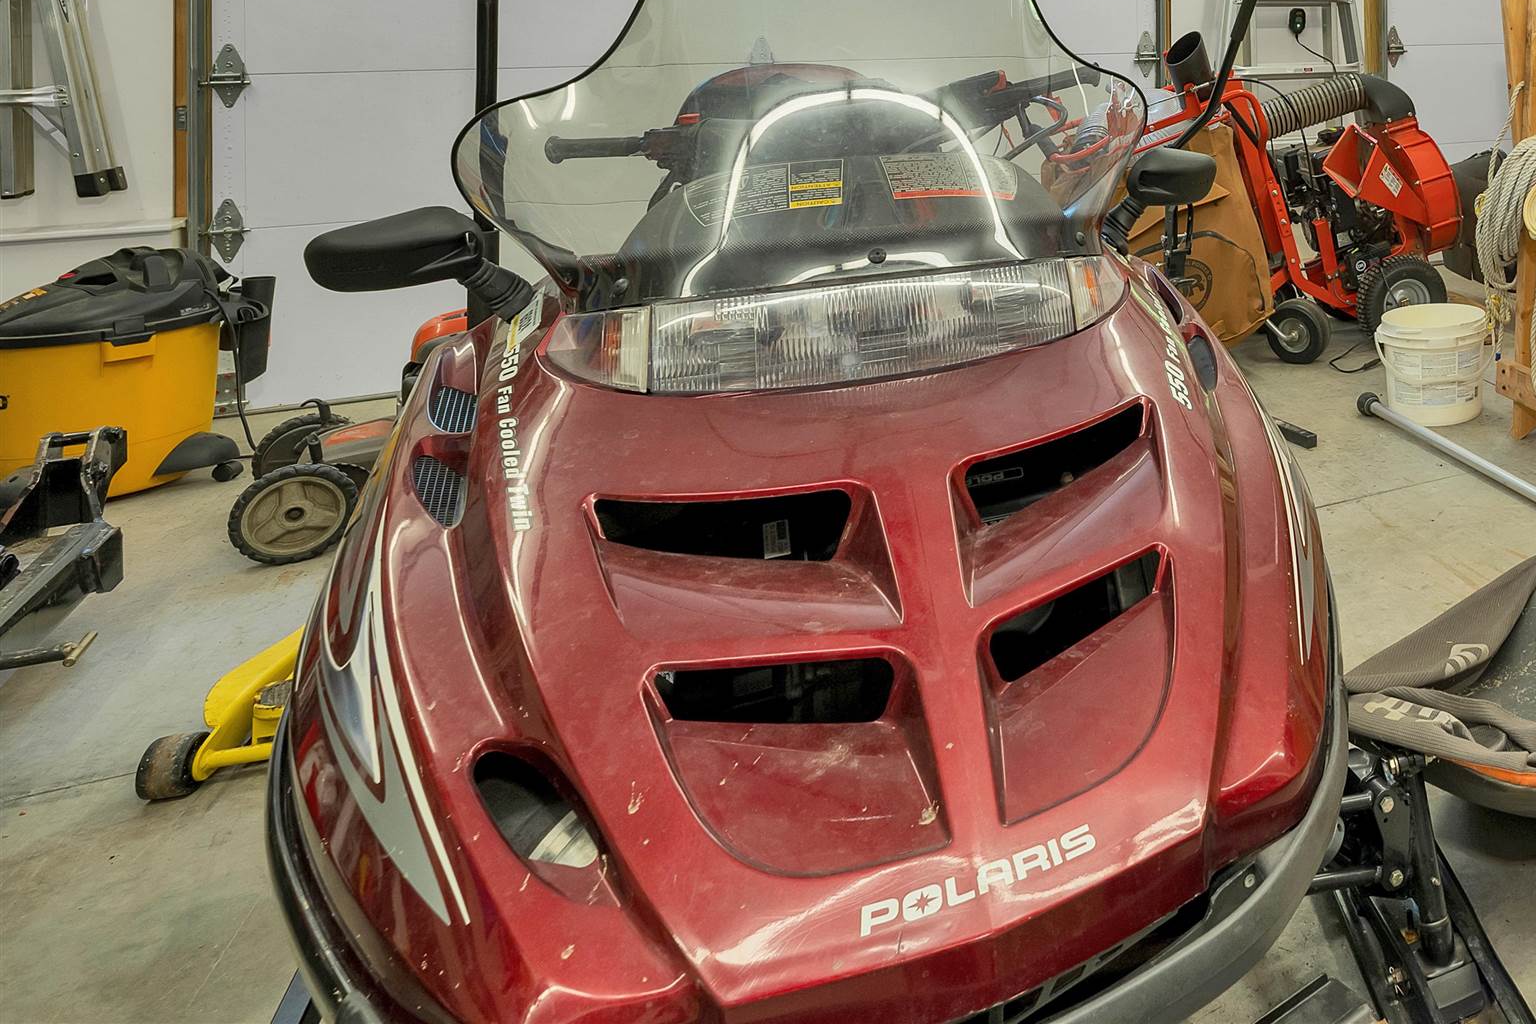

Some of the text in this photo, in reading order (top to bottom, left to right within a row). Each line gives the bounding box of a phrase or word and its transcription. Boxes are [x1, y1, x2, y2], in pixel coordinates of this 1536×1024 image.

[497, 386, 513, 414] Fan
[1164, 360, 1193, 410] 550
[499, 418, 526, 479] Cooled
[507, 484, 533, 532] Twin
[860, 823, 1097, 937] POLARIS
